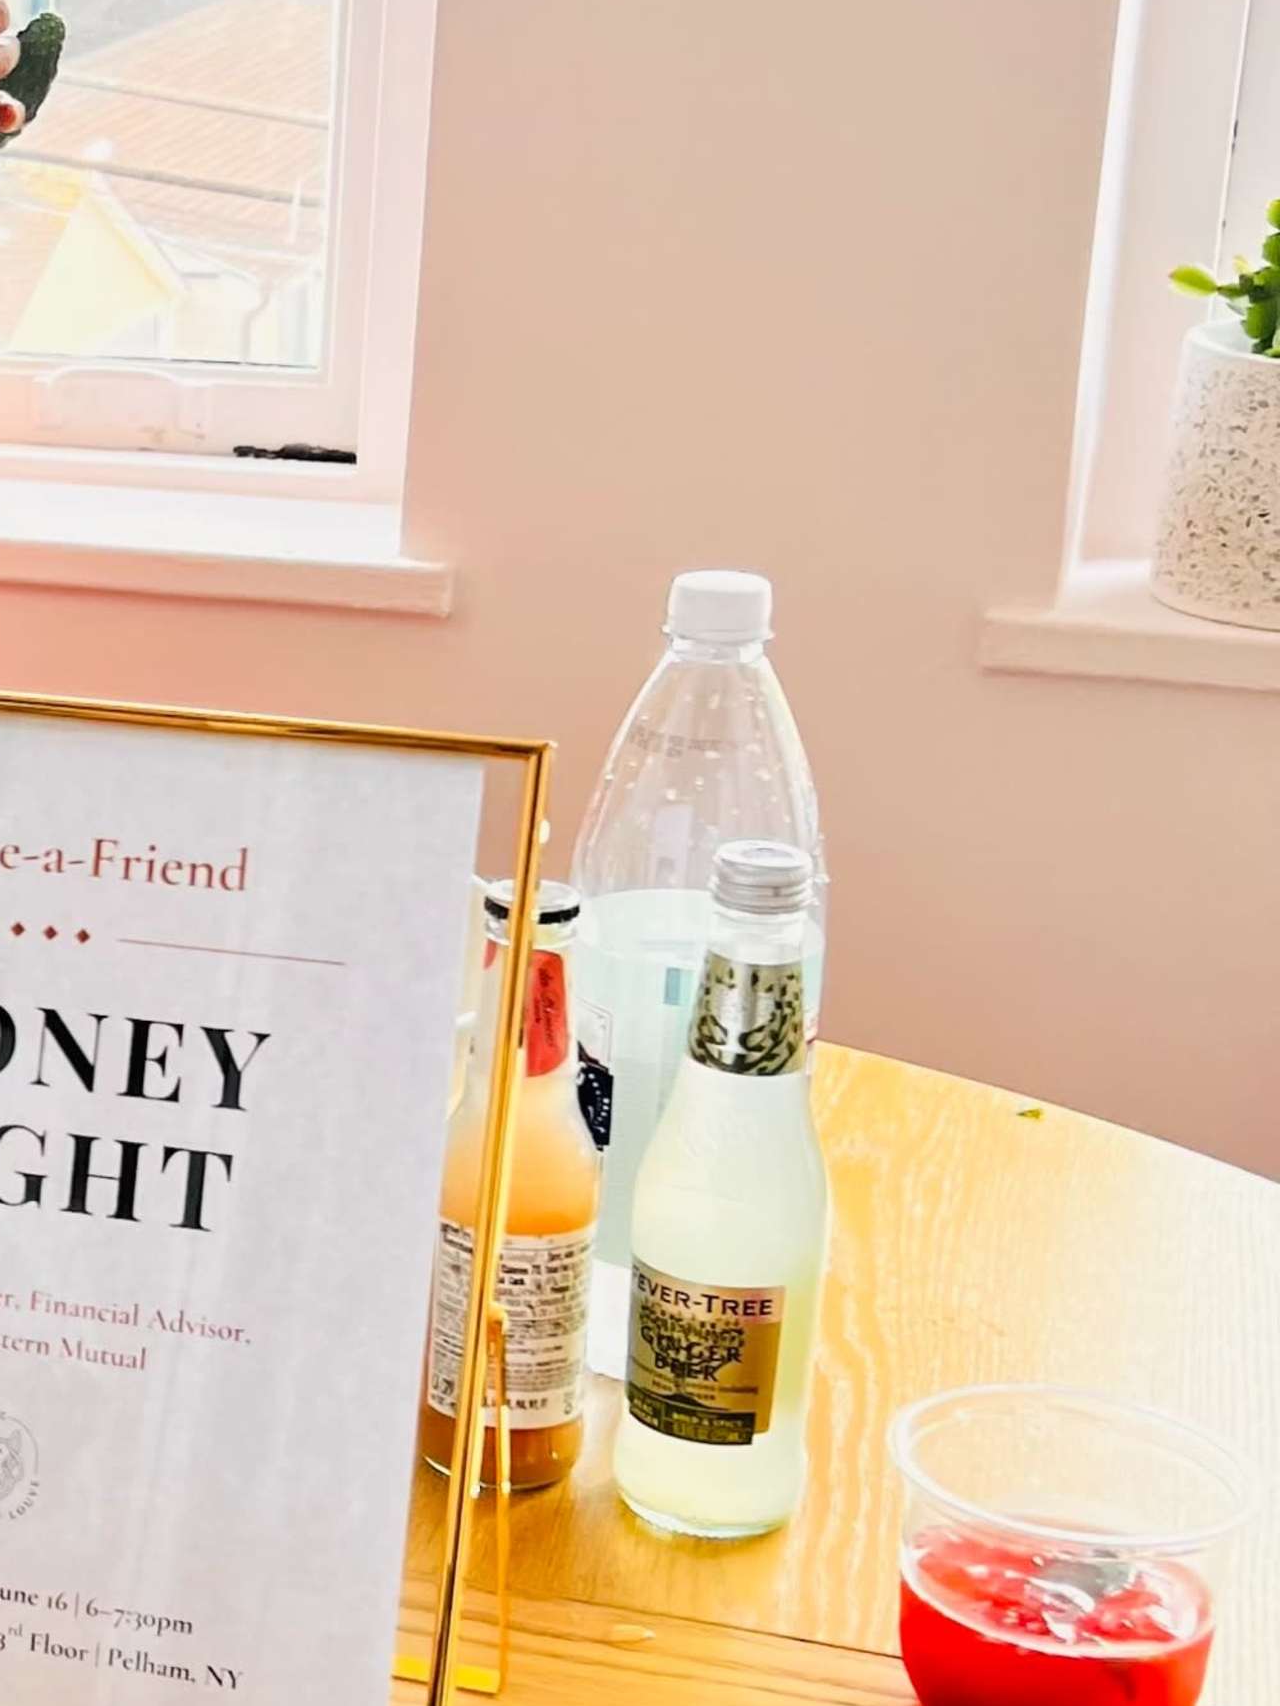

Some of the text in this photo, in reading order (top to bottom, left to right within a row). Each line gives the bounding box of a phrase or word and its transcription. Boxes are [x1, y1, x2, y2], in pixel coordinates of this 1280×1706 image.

[30, 1290, 140, 1327] Financial
[59, 1337, 147, 1371] Mutual
[47, 1592, 69, 1612] 16
[30, 1632, 89, 1662] Floor
[205, 1664, 244, 1690] NY
